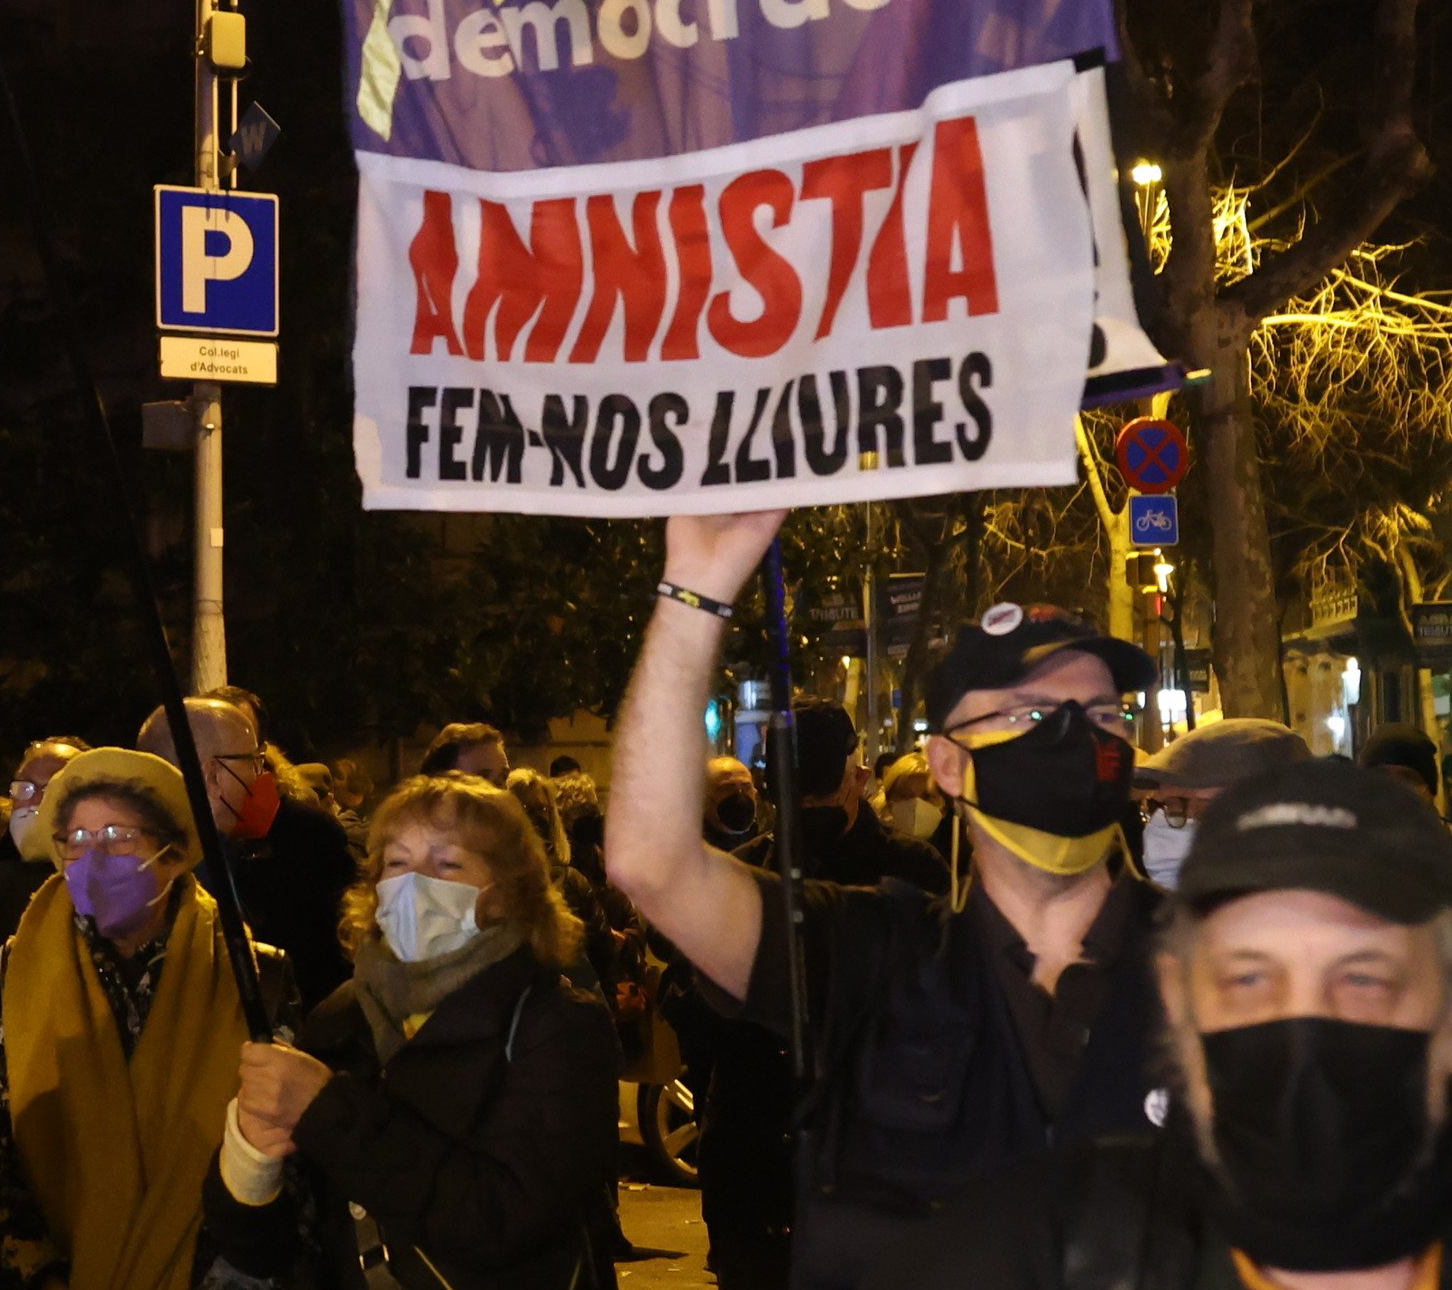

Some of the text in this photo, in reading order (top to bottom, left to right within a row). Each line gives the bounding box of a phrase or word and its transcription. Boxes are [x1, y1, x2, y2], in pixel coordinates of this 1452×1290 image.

[181, 205, 255, 314] P
[408, 116, 999, 364] AMNISTIA
[190, 362, 249, 374] d'Advocats
[406, 352, 992, 490] FEM-NOS LLIURES
